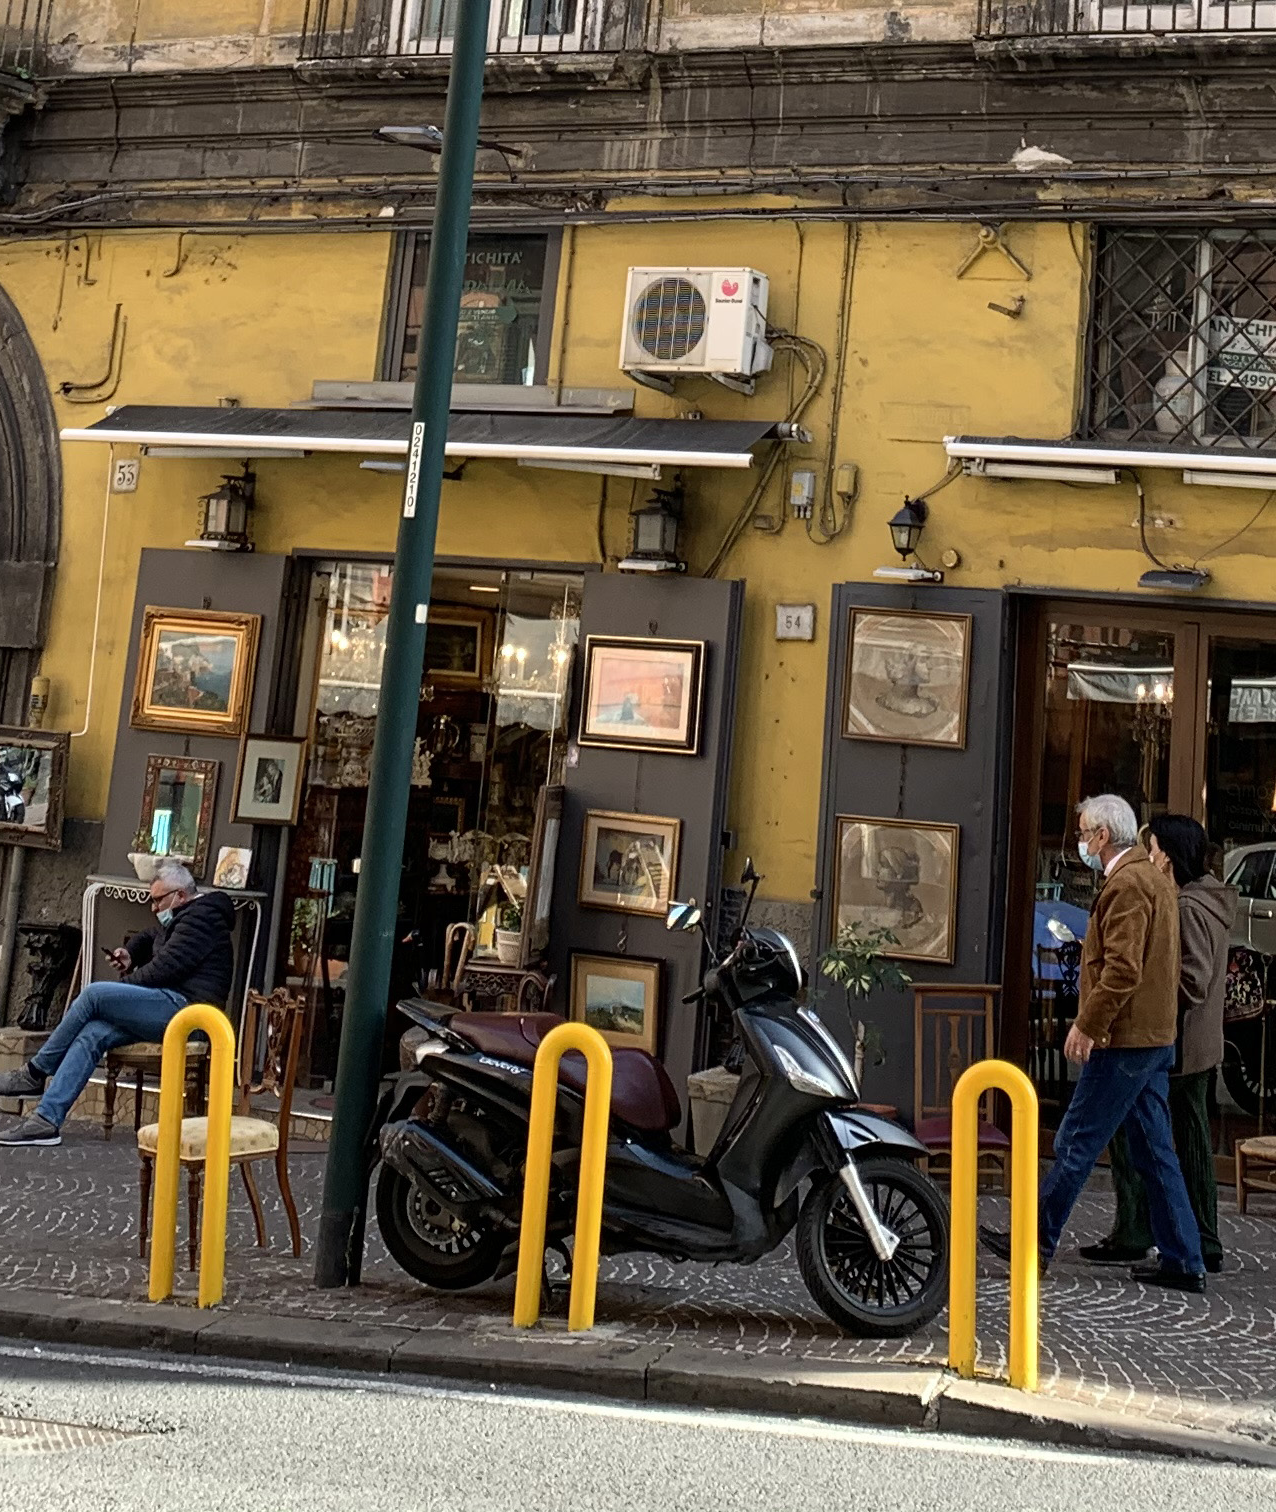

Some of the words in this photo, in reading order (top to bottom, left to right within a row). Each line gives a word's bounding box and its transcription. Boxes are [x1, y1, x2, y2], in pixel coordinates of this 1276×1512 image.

[465, 252, 523, 264] TICHITA'
[407, 425, 422, 507] 0241210
[785, 615, 801, 629] 54
